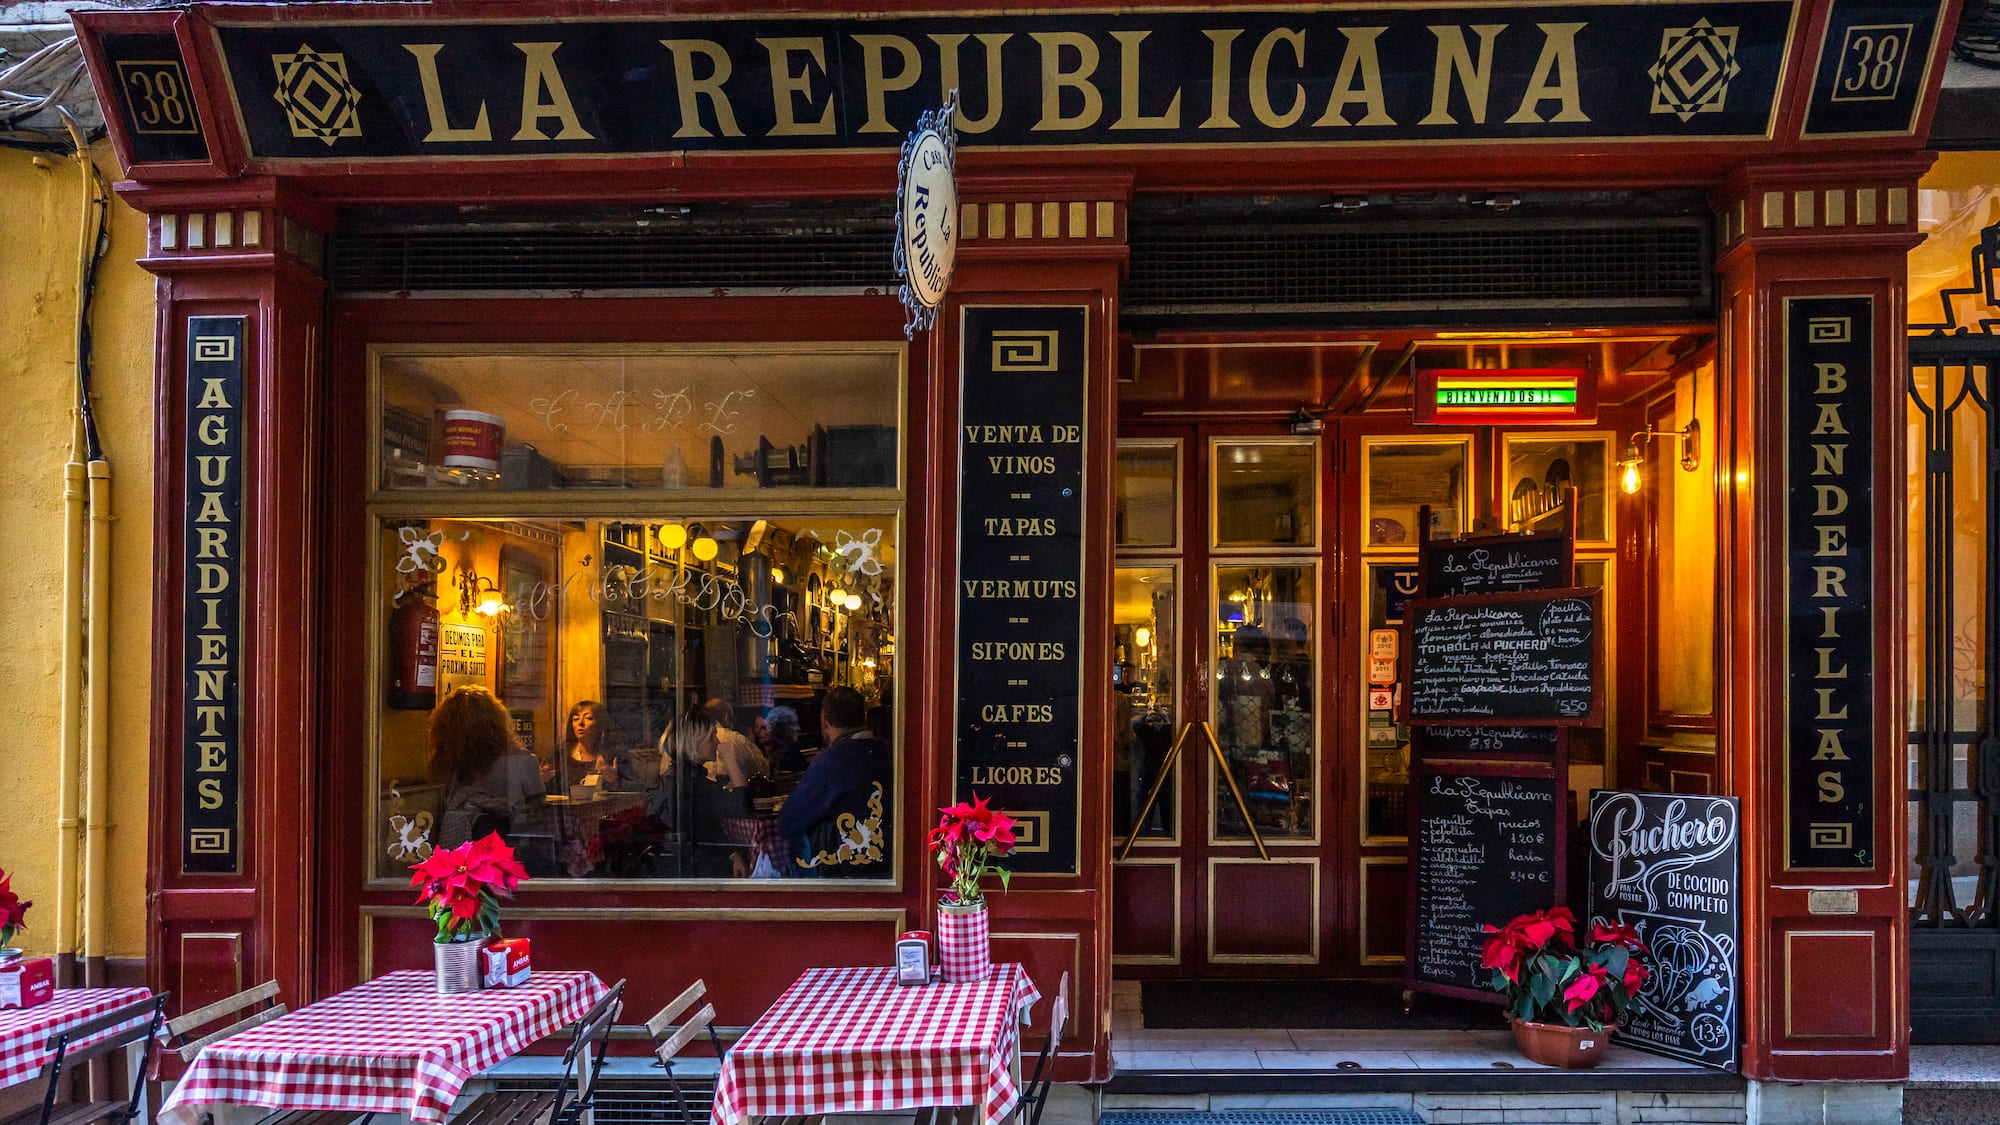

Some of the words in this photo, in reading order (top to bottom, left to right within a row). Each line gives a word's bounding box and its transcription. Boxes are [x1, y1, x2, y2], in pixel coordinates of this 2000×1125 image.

[1845, 35, 1898, 92] 38
[401, 41, 597, 143] LA
[658, 21, 1592, 138] REPUBLICANA
[130, 71, 187, 126] 38
[923, 149, 942, 171] Casa
[939, 206, 952, 246] La
[965, 425, 1044, 444] VENTA
[1051, 425, 1080, 443] DE
[988, 456, 1056, 475] VINOS
[984, 518, 1057, 537] TAPAS
[1443, 554, 1468, 573] La
[1468, 549, 1559, 575] Republicana
[1461, 574, 1484, 582] casa
[1501, 569, 1543, 579] comidas
[1809, 362, 1851, 803] BANDERILLAS
[193, 377, 233, 811] AGUARDIENTES
[963, 580, 1077, 599] VERMUTS
[1425, 609, 1443, 623] La
[1444, 608, 1523, 627] Republicana
[1549, 602, 1582, 618] paella
[1542, 615, 1562, 628] plato
[445, 630, 470, 647] DECIMOS
[471, 633, 485, 647] PARA
[1418, 641, 1479, 656] TOMBOLA
[1493, 639, 1548, 652] PUCHERO
[460, 649, 475, 658] EL
[971, 642, 1065, 661] SIFONES
[1482, 650, 1529, 664] popular
[442, 659, 468, 675] PROXIMO
[981, 704, 1053, 723] CAFES
[971, 767, 1063, 786] LICORES
[1430, 775, 1460, 796] La
[1455, 776, 1553, 807] Republicana
[1464, 798, 1511, 820] Tapas
[1430, 814, 1475, 829] piquillo
[1430, 825, 1476, 836] cebollita
[1498, 819, 1541, 835] precios
[1430, 833, 1455, 844] bola
[1591, 792, 1737, 888] Puchero
[1620, 883, 1632, 893] PAN
[1667, 873, 1681, 891] DE
[1683, 874, 1729, 896] COCIDO
[1620, 892, 1643, 903] POSTRE
[1667, 891, 1728, 915] COMPLETO
[1630, 1026, 1650, 1039] TODOS
[1651, 1030, 1664, 1041] LOS
